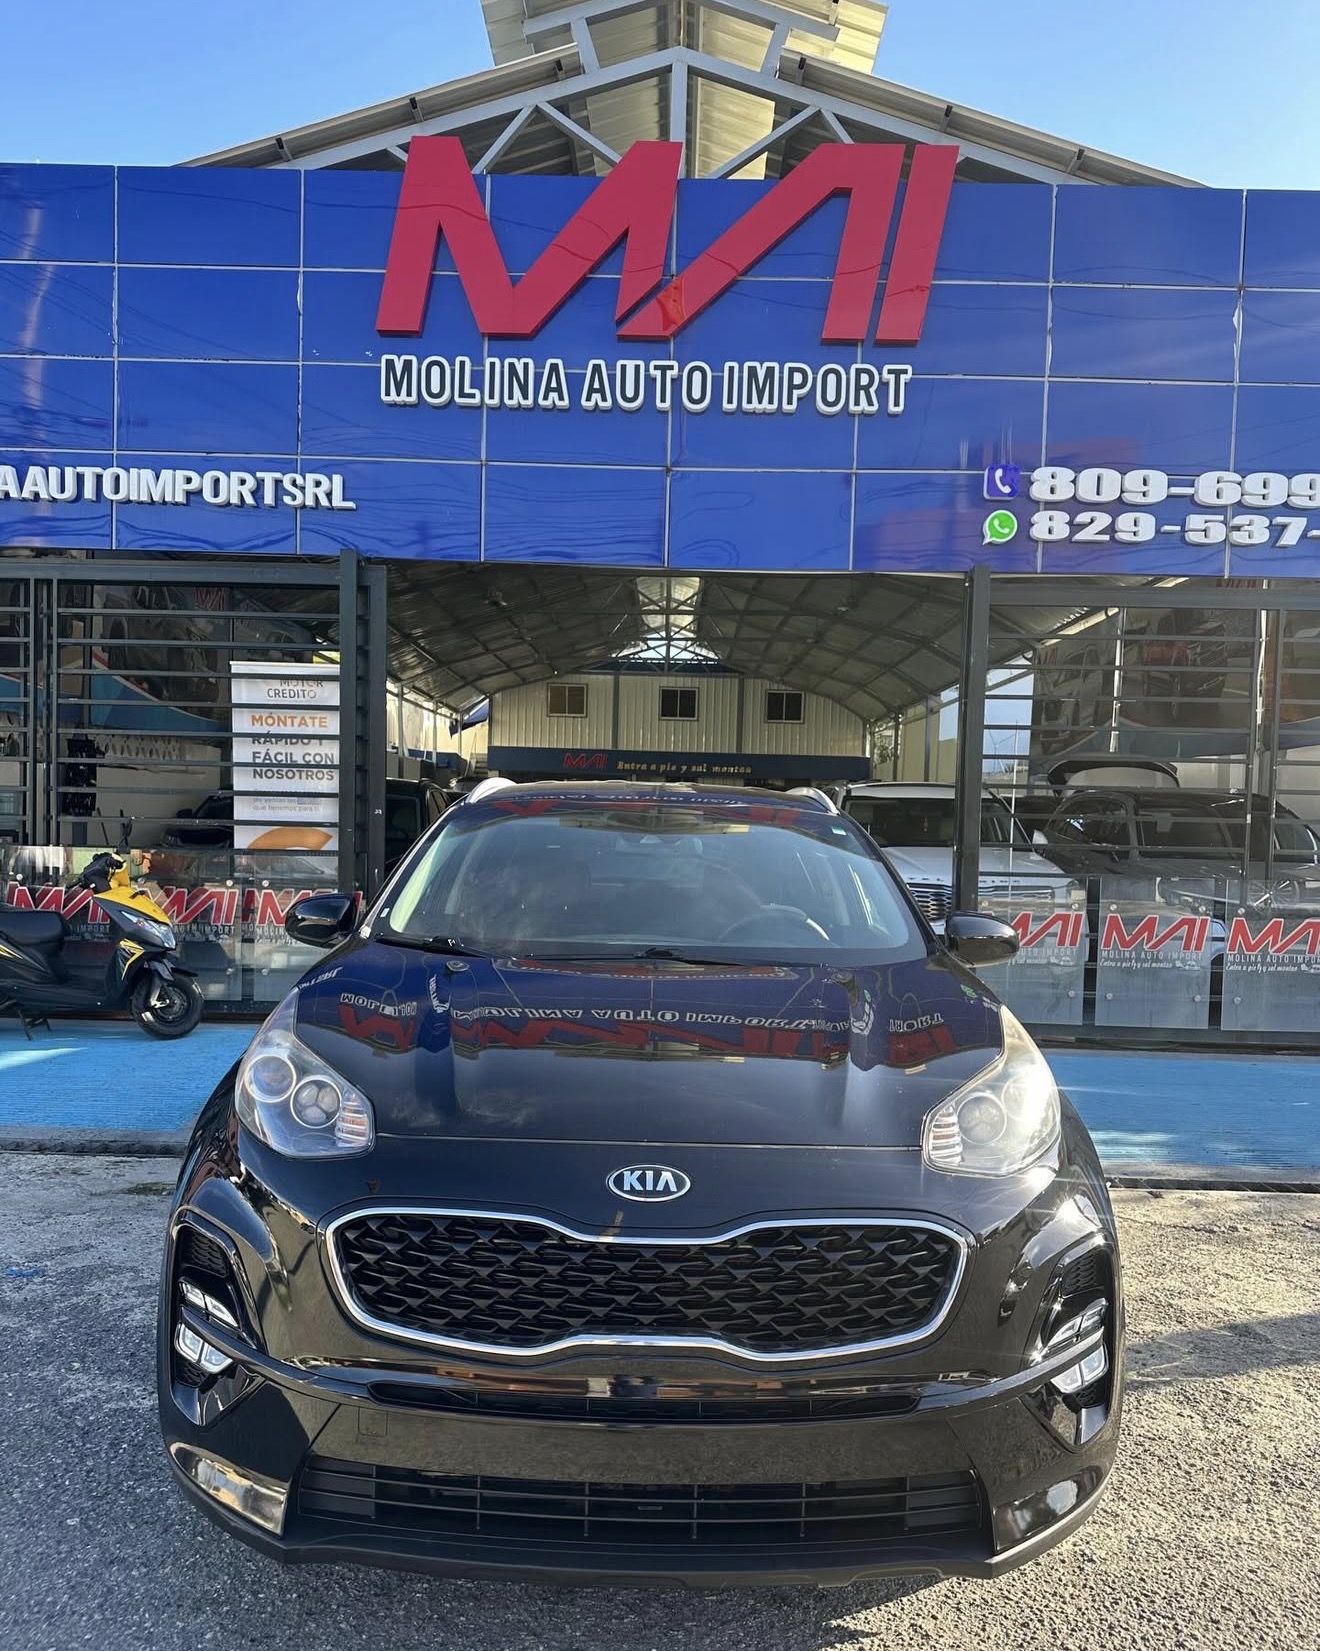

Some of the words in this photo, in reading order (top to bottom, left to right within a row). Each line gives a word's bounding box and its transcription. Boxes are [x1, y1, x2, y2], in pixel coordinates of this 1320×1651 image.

[376, 136, 960, 345] MAI
[380, 354, 570, 411] MOLINA
[581, 358, 712, 412] AUTO
[723, 361, 912, 416] IMPORT
[0, 465, 357, 510] AAUTOIMPORTSRL
[1029, 466, 1320, 509] 809-699
[266, 688, 317, 699] CREDITO
[251, 712, 328, 728] MÓNTATE
[251, 748, 298, 764] FÁCIL
[302, 752, 335, 764] CON
[564, 753, 608, 770] MAI
[252, 768, 335, 781] NOSOTROS
[1101, 913, 1212, 952] MAI
[1101, 950, 1136, 959] MOLINA
[1140, 951, 1164, 959] AUTO
[1167, 952, 1202, 961] IMPORT
[1227, 953, 1262, 963] MOLINA
[1266, 954, 1290, 963] AUTO
[623, 1170, 678, 1192] KIA
